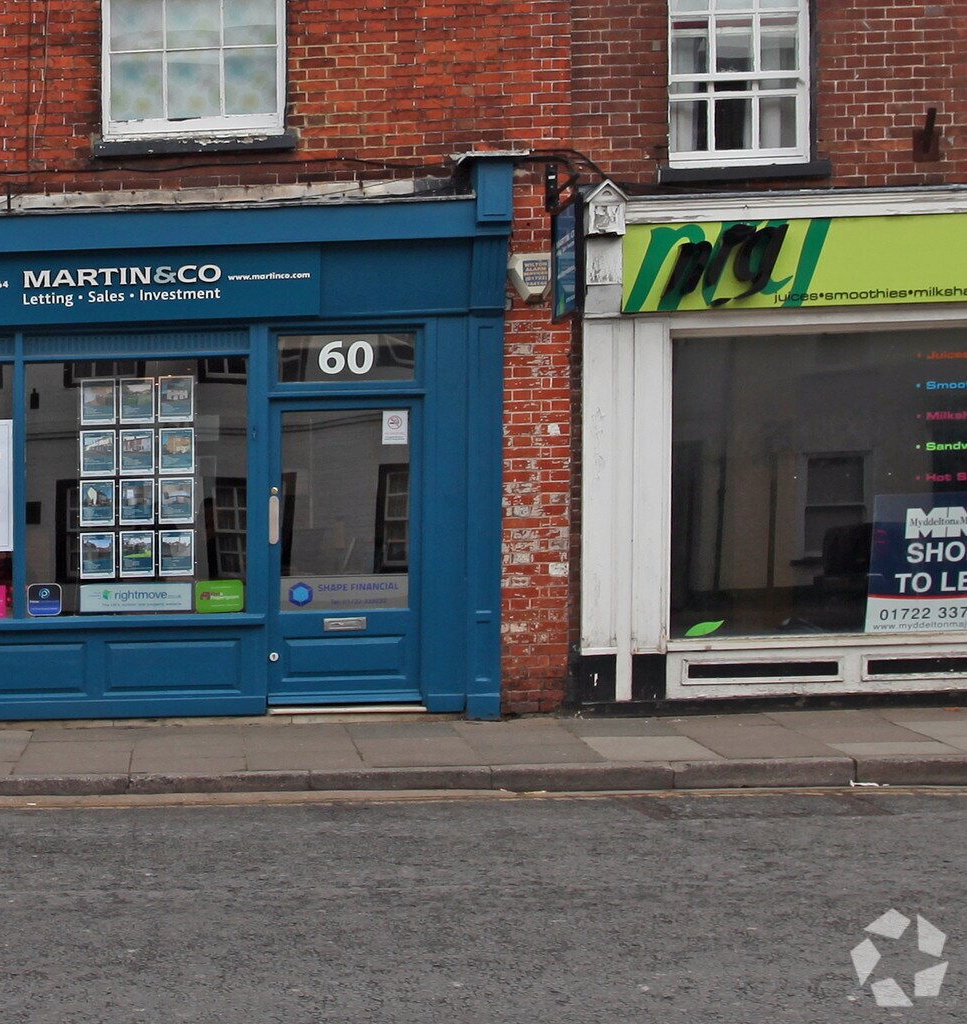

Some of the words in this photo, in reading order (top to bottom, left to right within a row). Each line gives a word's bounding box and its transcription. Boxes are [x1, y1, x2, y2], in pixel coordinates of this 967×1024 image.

[23, 264, 222, 288] MARTIN&CO
[227, 271, 311, 281] www.martinco.com
[22, 292, 74, 307] Letting
[88, 290, 125, 303] Sales
[139, 287, 221, 301] Investment
[318, 340, 374, 375] 60
[906, 541, 967, 564] SHO
[318, 583, 348, 592] SHAPE
[350, 582, 399, 590] FINANCIAL
[894, 572, 932, 593] TO
[879, 608, 931, 621] 01722
[937, 606, 967, 619] 337
